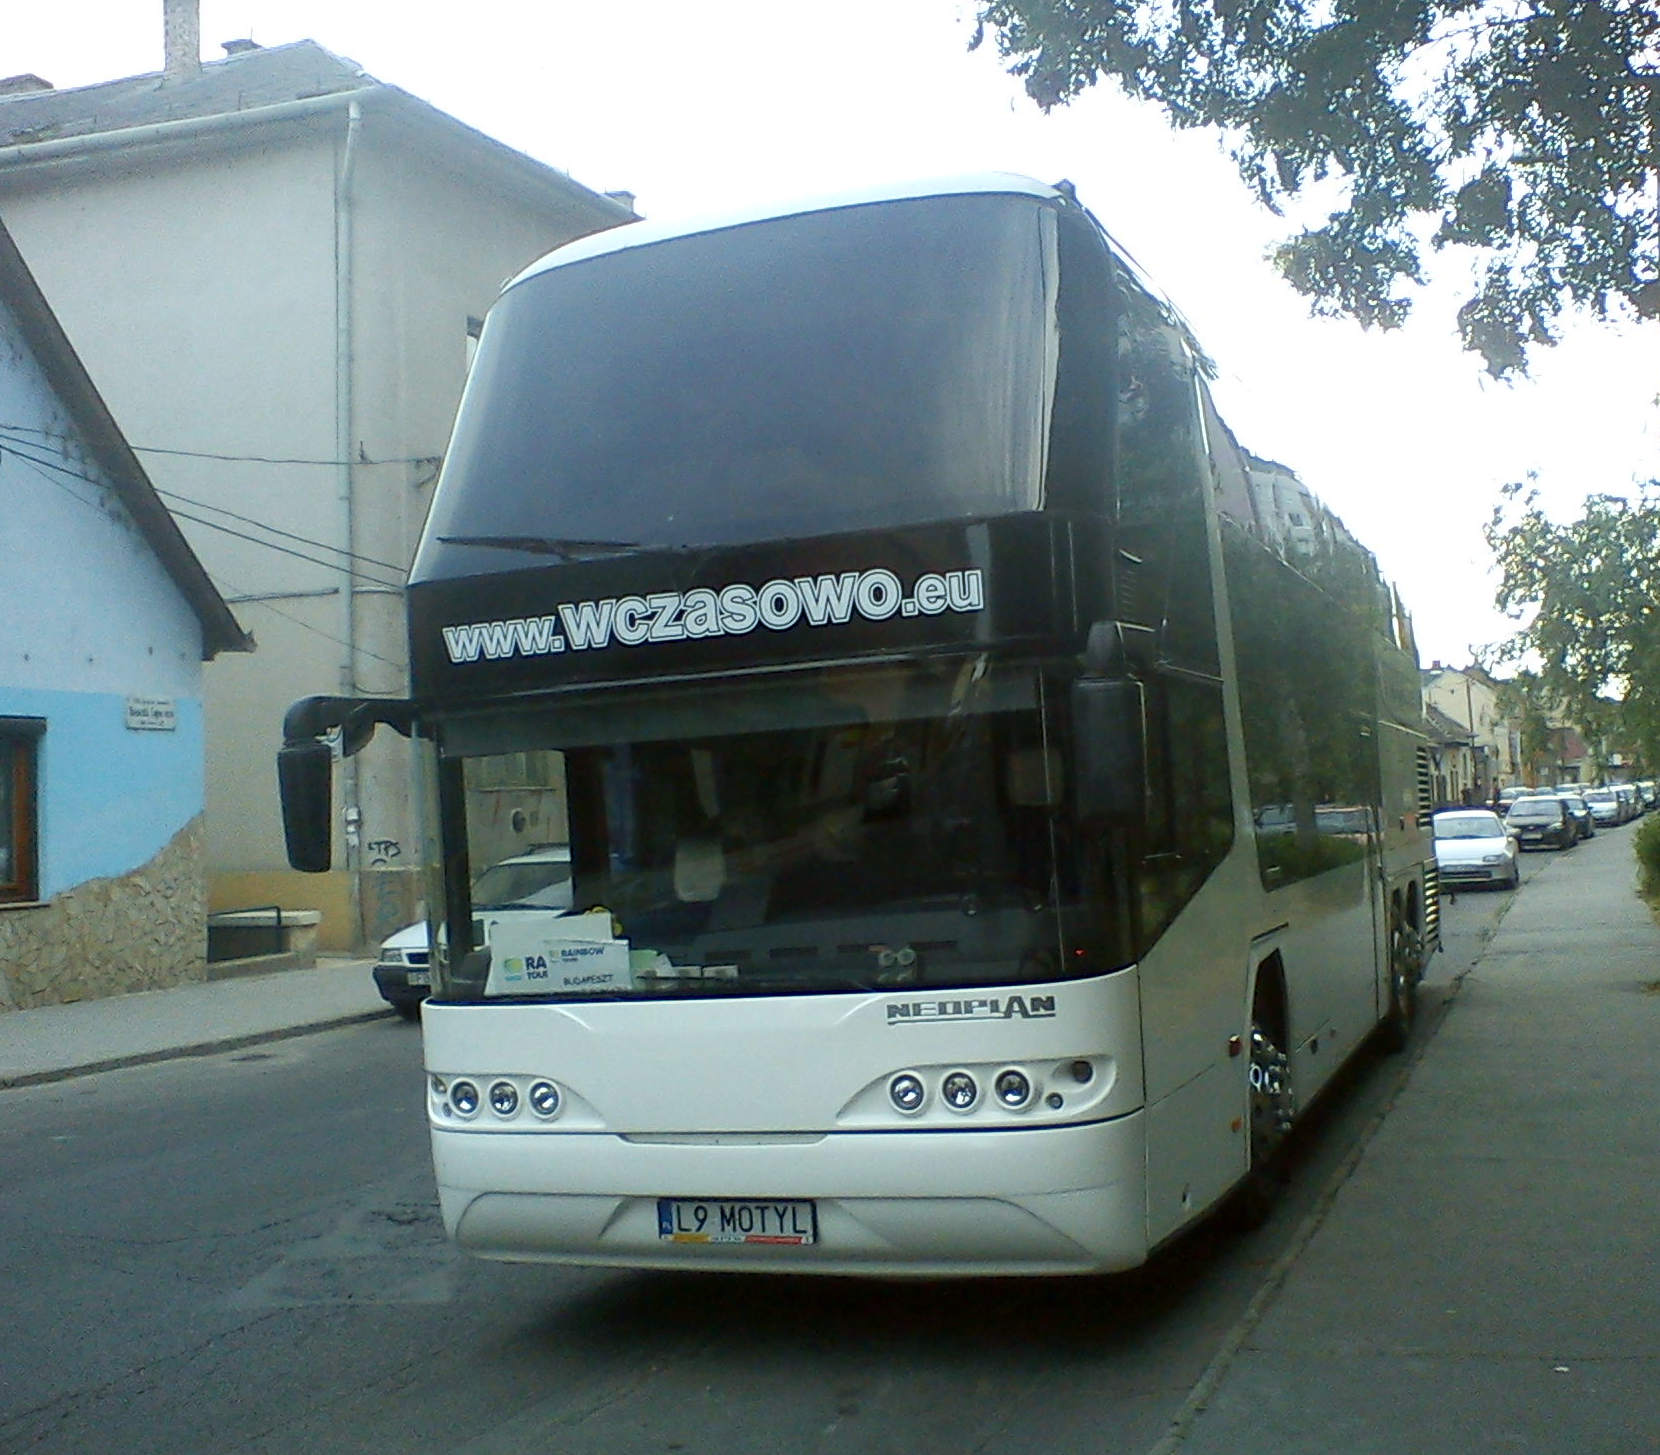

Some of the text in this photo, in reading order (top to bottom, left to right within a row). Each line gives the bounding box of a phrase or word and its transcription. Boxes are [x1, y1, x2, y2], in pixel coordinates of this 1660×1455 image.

[442, 568, 986, 663] www.wczasowo.eu
[525, 955, 547, 970] RA
[886, 995, 1056, 1021] NEOPLAN
[676, 1204, 808, 1235] L9 MOTYL
